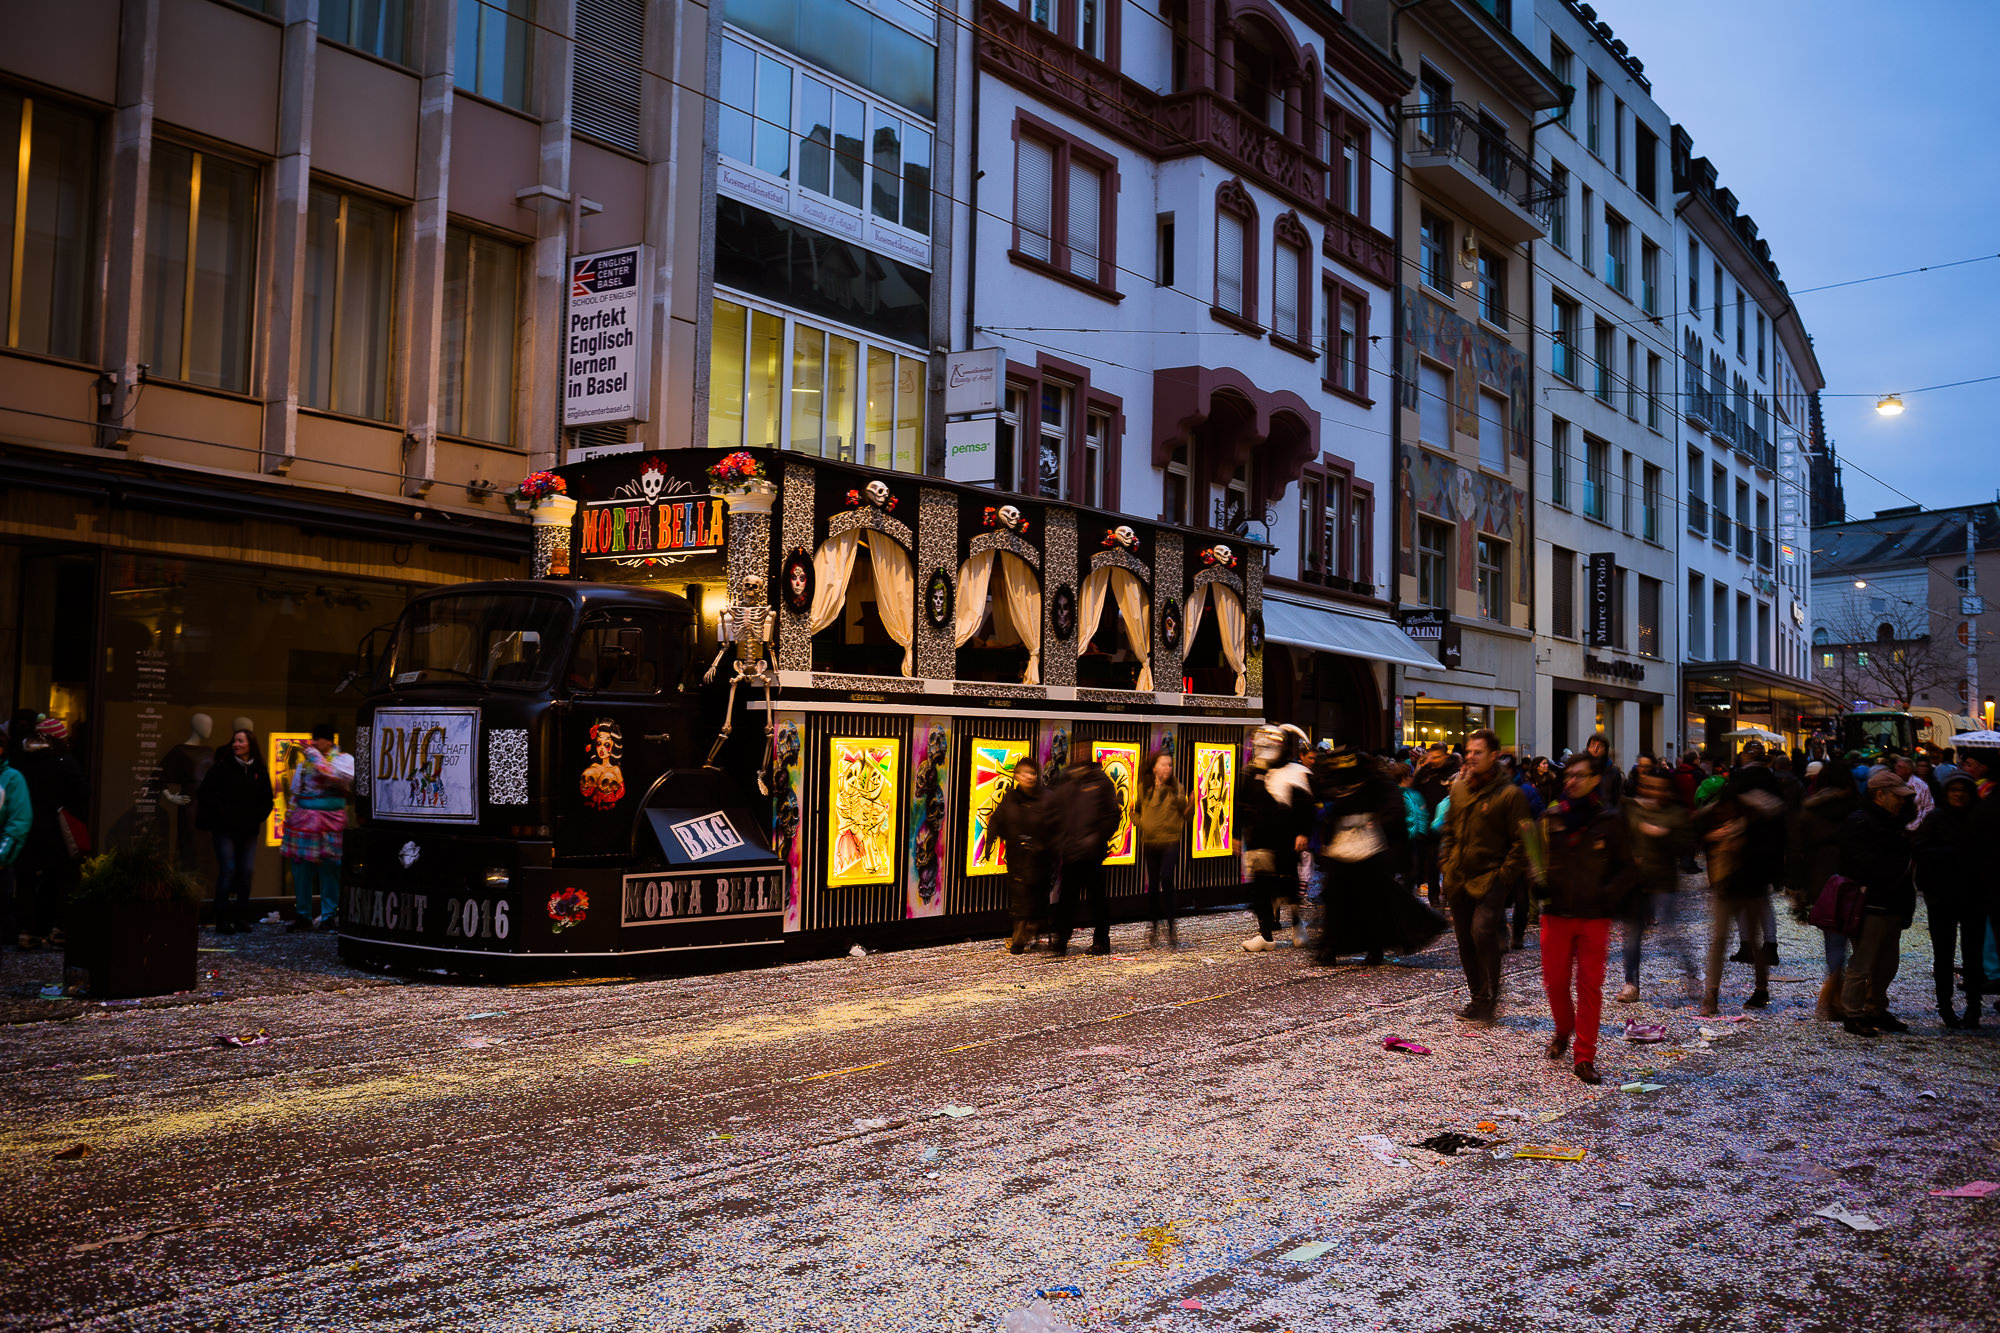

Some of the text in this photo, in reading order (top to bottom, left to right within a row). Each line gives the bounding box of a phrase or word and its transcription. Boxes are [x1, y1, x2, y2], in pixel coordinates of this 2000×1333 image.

[723, 170, 784, 205] Kosmetikinstitut
[801, 203, 827, 223] Beauty
[874, 229, 925, 259] Kosmetikinstitut
[597, 255, 633, 270] ENGLISH
[597, 266, 630, 280] CENTER
[597, 277, 623, 289] BASEL
[571, 289, 637, 307] SCHOOL OF ENGLISH
[571, 306, 626, 333] Perfekt
[570, 327, 633, 357] Englisch
[569, 355, 617, 377] lernen
[568, 372, 628, 398] in Basel
[567, 404, 631, 419] englishcenterbasel.ch
[952, 442, 988, 457] pemsa
[580, 499, 725, 554] MORTA BELLA
[1596, 557, 1607, 641] Marc O'Polo
[1404, 626, 1440, 637] LATINI
[376, 726, 447, 783] BMG
[676, 815, 738, 857] BMG
[624, 875, 782, 919] MORTA BELLA
[446, 897, 510, 940] 2016
